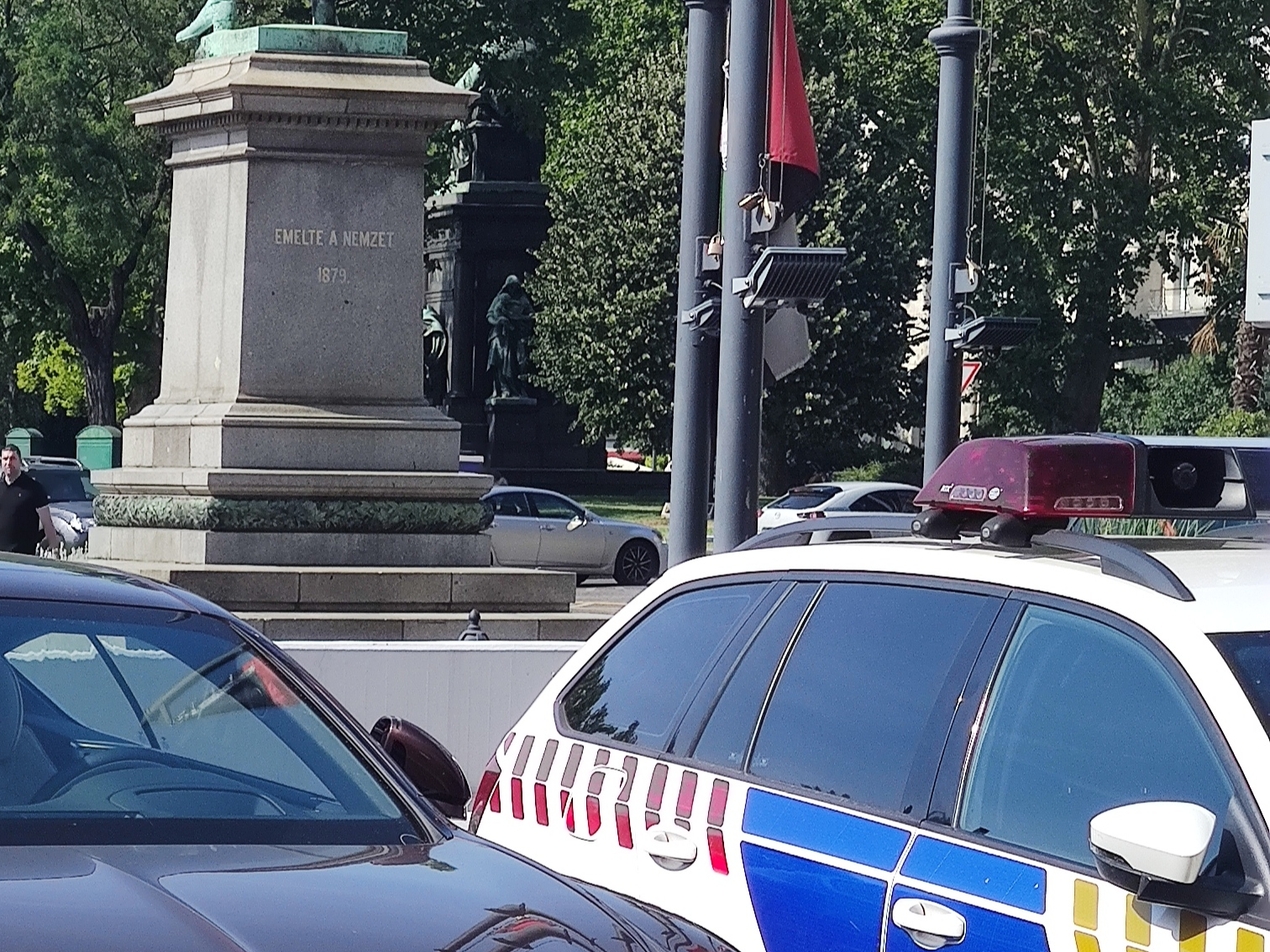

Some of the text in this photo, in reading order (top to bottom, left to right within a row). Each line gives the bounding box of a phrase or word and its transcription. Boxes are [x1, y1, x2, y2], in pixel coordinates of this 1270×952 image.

[275, 229, 394, 247] EMELTE A NEMZET
